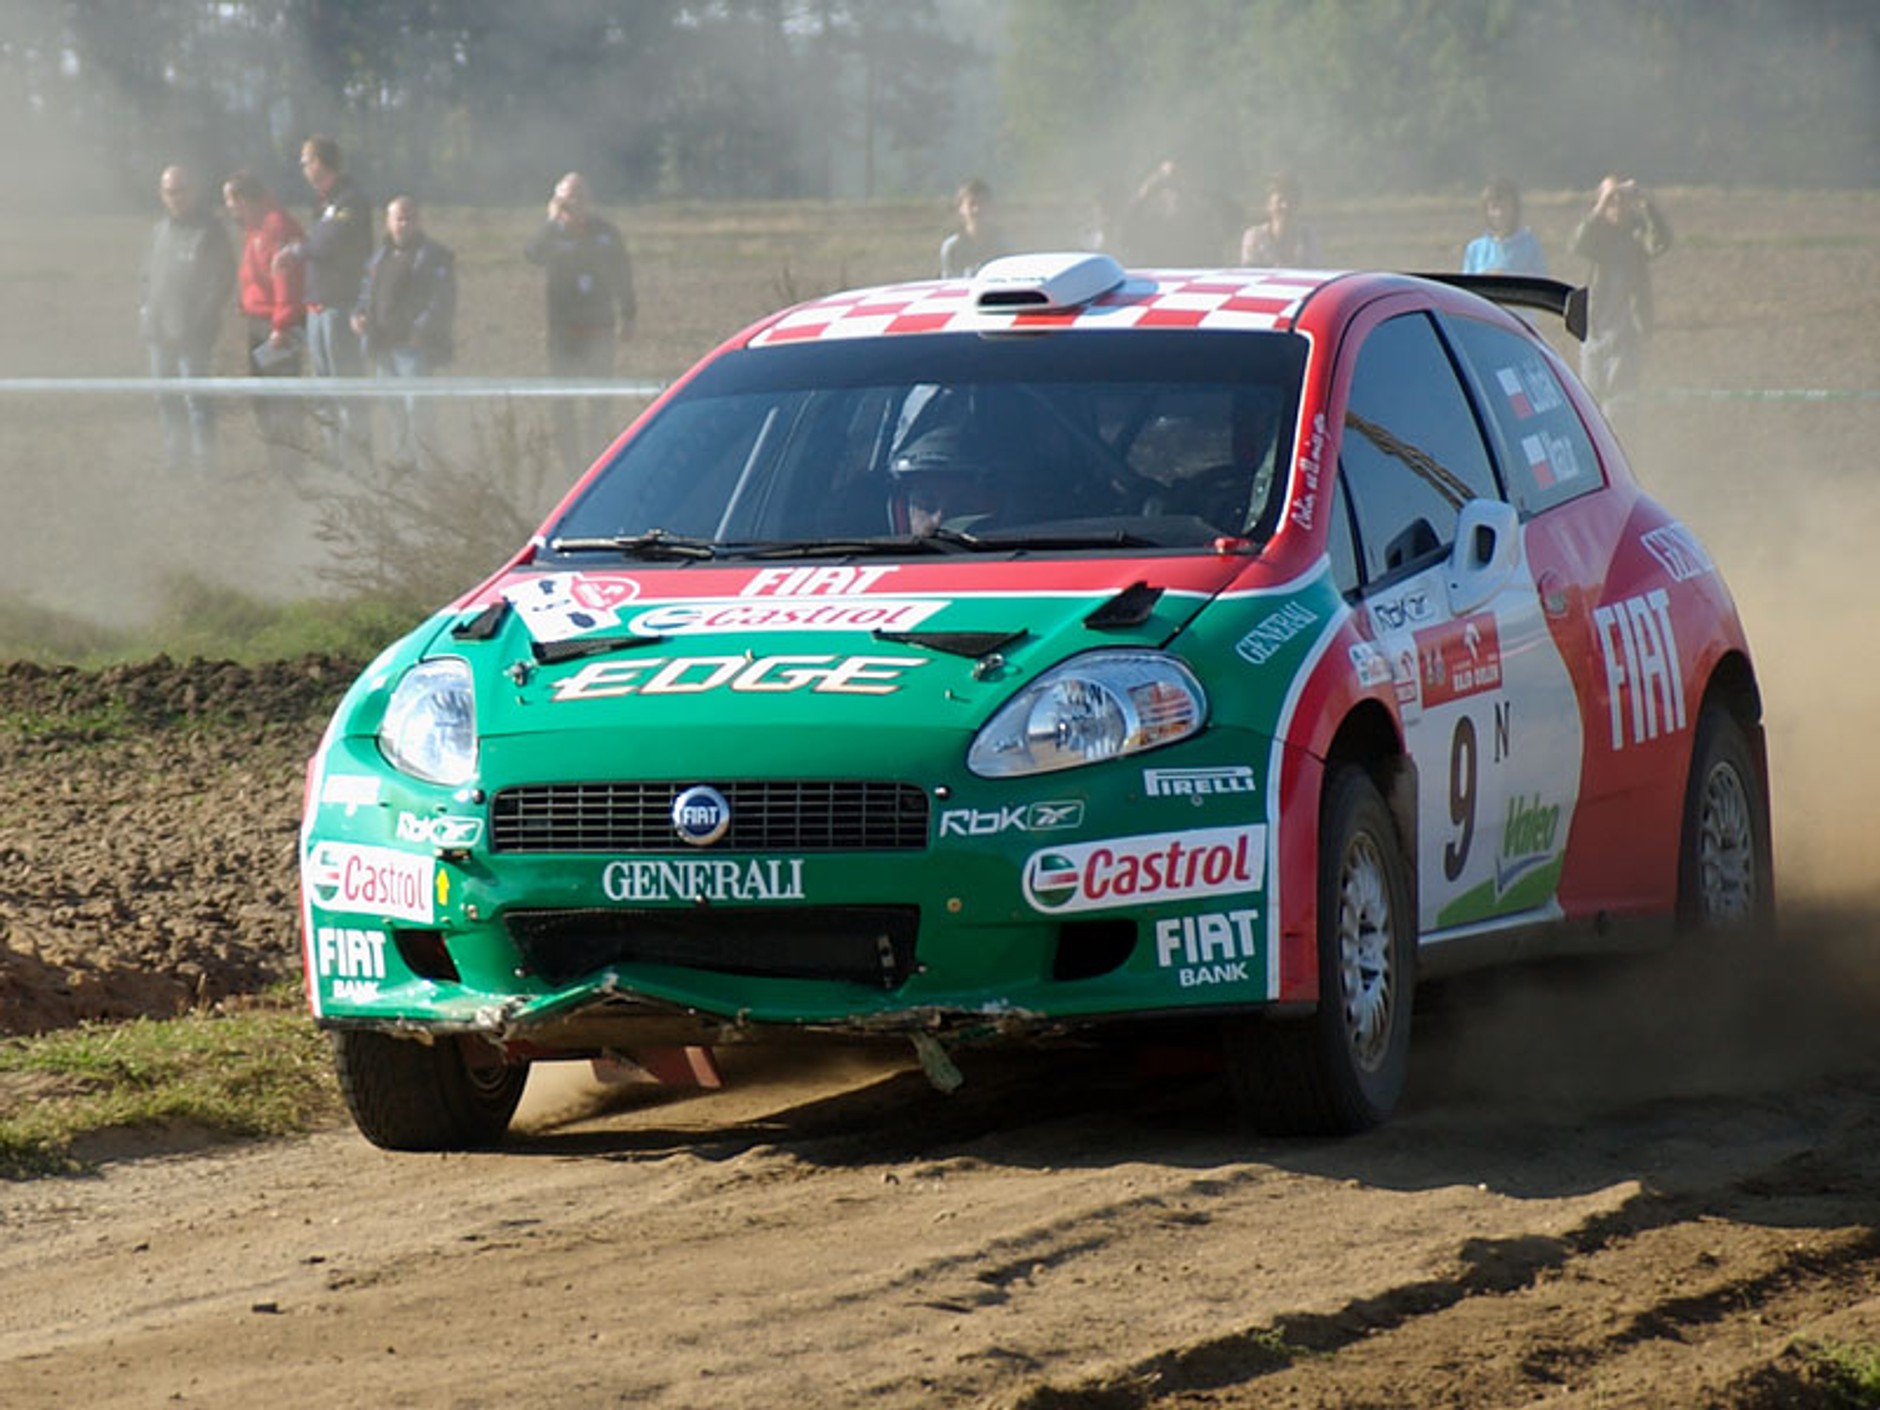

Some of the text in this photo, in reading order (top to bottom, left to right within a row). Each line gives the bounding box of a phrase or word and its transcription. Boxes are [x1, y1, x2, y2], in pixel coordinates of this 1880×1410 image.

[740, 566, 900, 597] FIAT
[705, 605, 913, 627] Castrol
[1235, 600, 1318, 664] GENERALI
[550, 655, 929, 701] EDGE
[1593, 587, 1687, 751] FIAT
[1494, 700, 1511, 764] N
[1143, 766, 1256, 796] PIRELLI
[1444, 714, 1478, 882] 9
[682, 806, 719, 826] FIAT
[939, 805, 1030, 838] RbK
[1503, 793, 1560, 858] Valeo
[343, 854, 427, 911] Castrol
[603, 858, 806, 901] GENERALI
[1082, 834, 1251, 900] Castrol
[317, 927, 386, 979] FIAT
[1155, 909, 1259, 968] FIAT
[332, 980, 380, 1004] BANK
[1179, 962, 1250, 988] BANK
